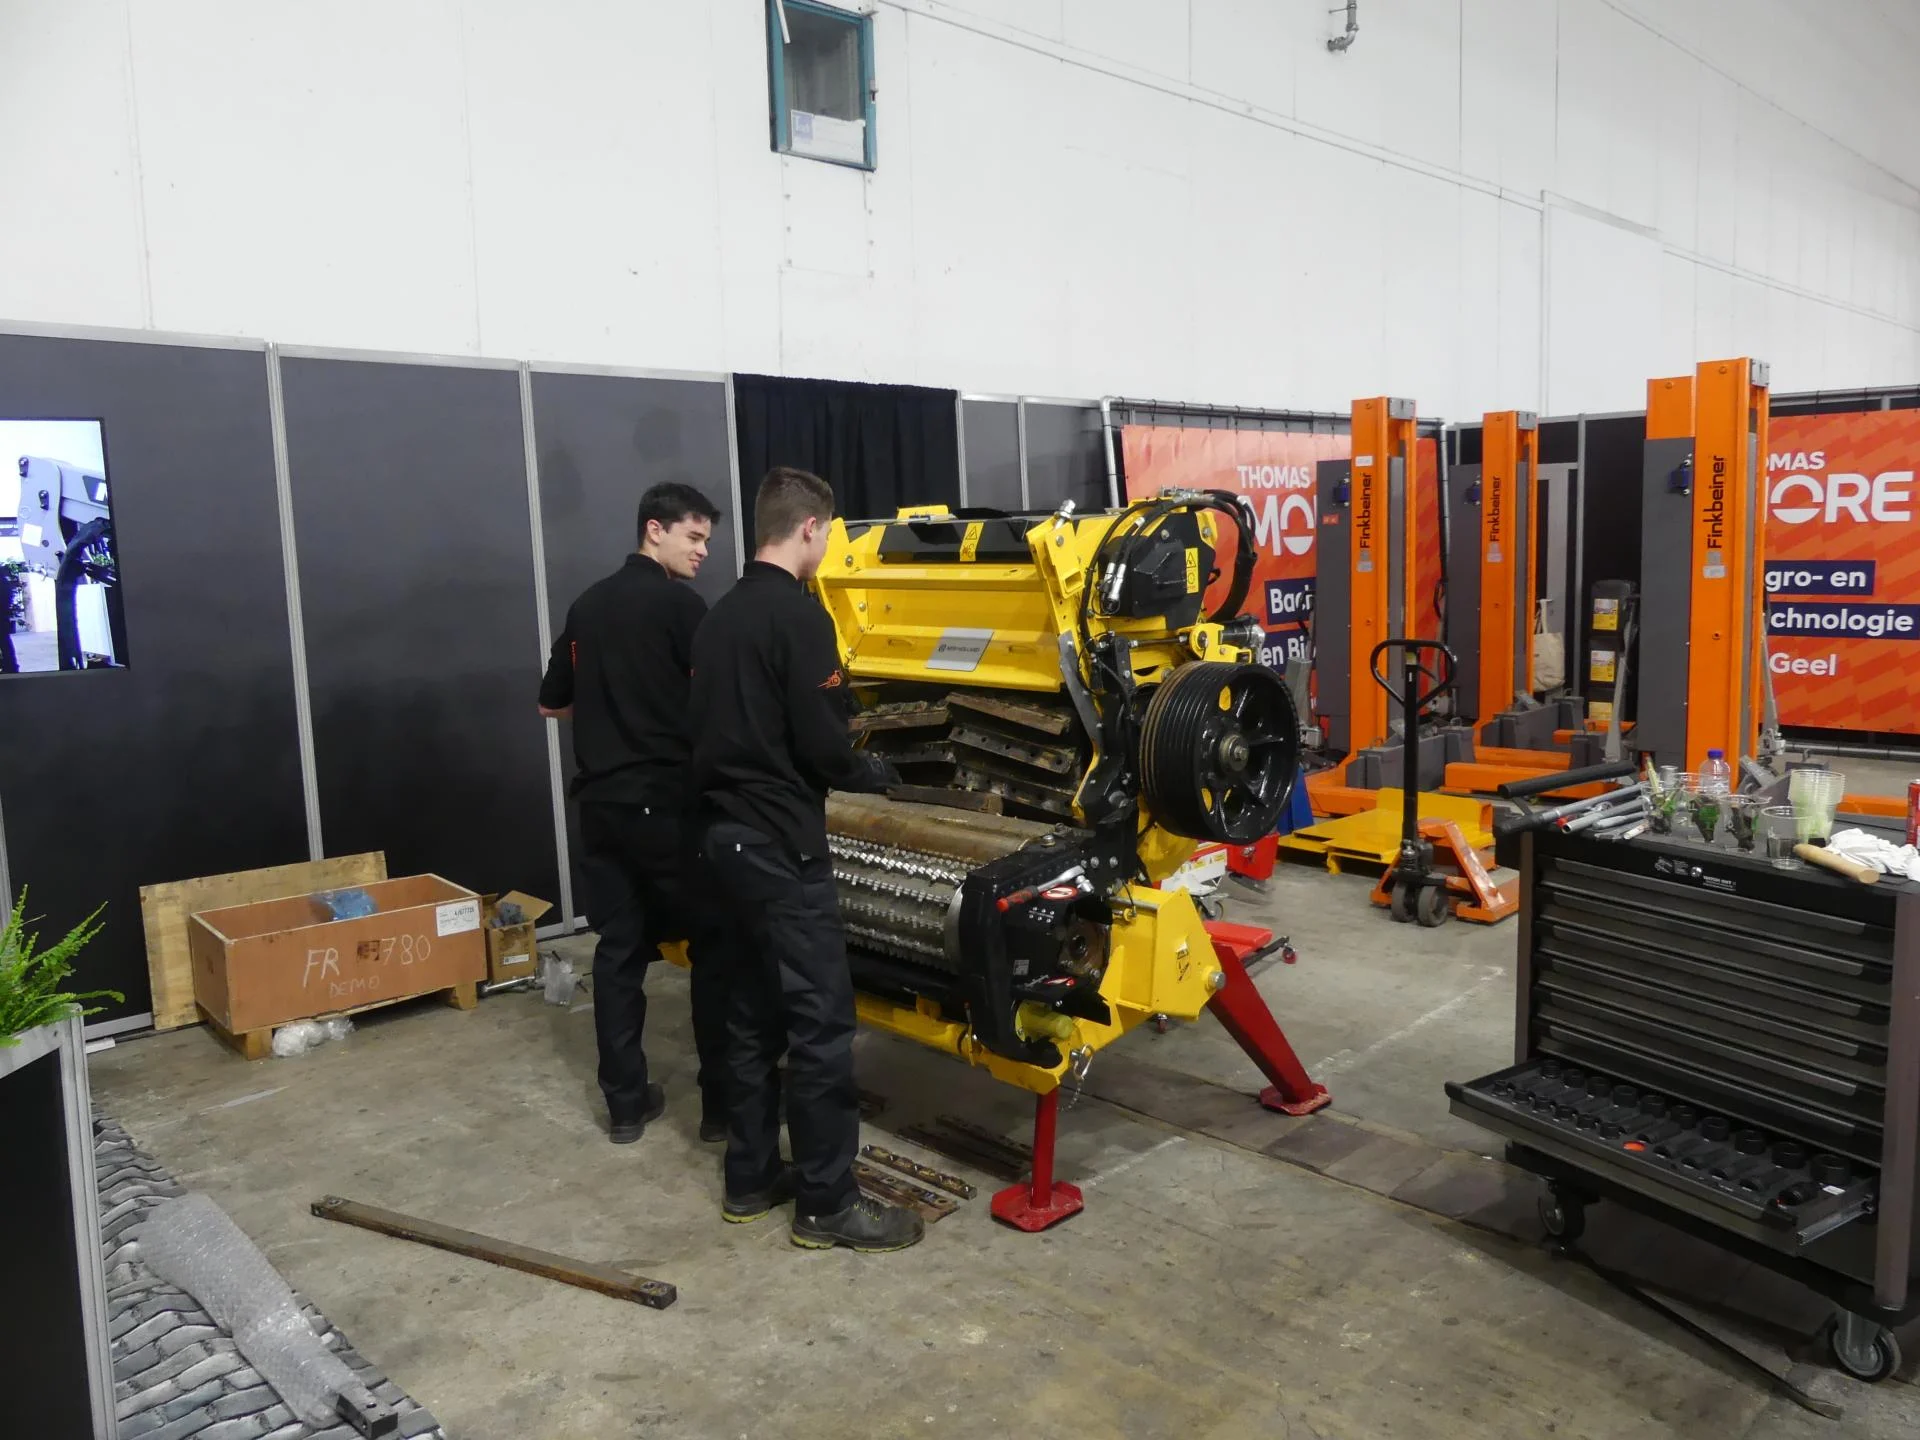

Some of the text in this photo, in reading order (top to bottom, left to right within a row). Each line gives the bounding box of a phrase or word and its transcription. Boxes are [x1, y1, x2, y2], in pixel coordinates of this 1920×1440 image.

[1237, 465, 1310, 489] THOMAS
[1765, 451, 1825, 471] MAS
[1356, 472, 1372, 549] Finkbeiner
[1487, 476, 1501, 542] Finkbeiner
[1703, 455, 1726, 549] Finkbeiner
[1764, 471, 1914, 524] ORE
[1238, 494, 1317, 556] MO
[1830, 570, 1866, 588] en
[1769, 652, 1837, 676] Geel
[303, 933, 431, 988] FR 780
[329, 975, 380, 998] DEMO
